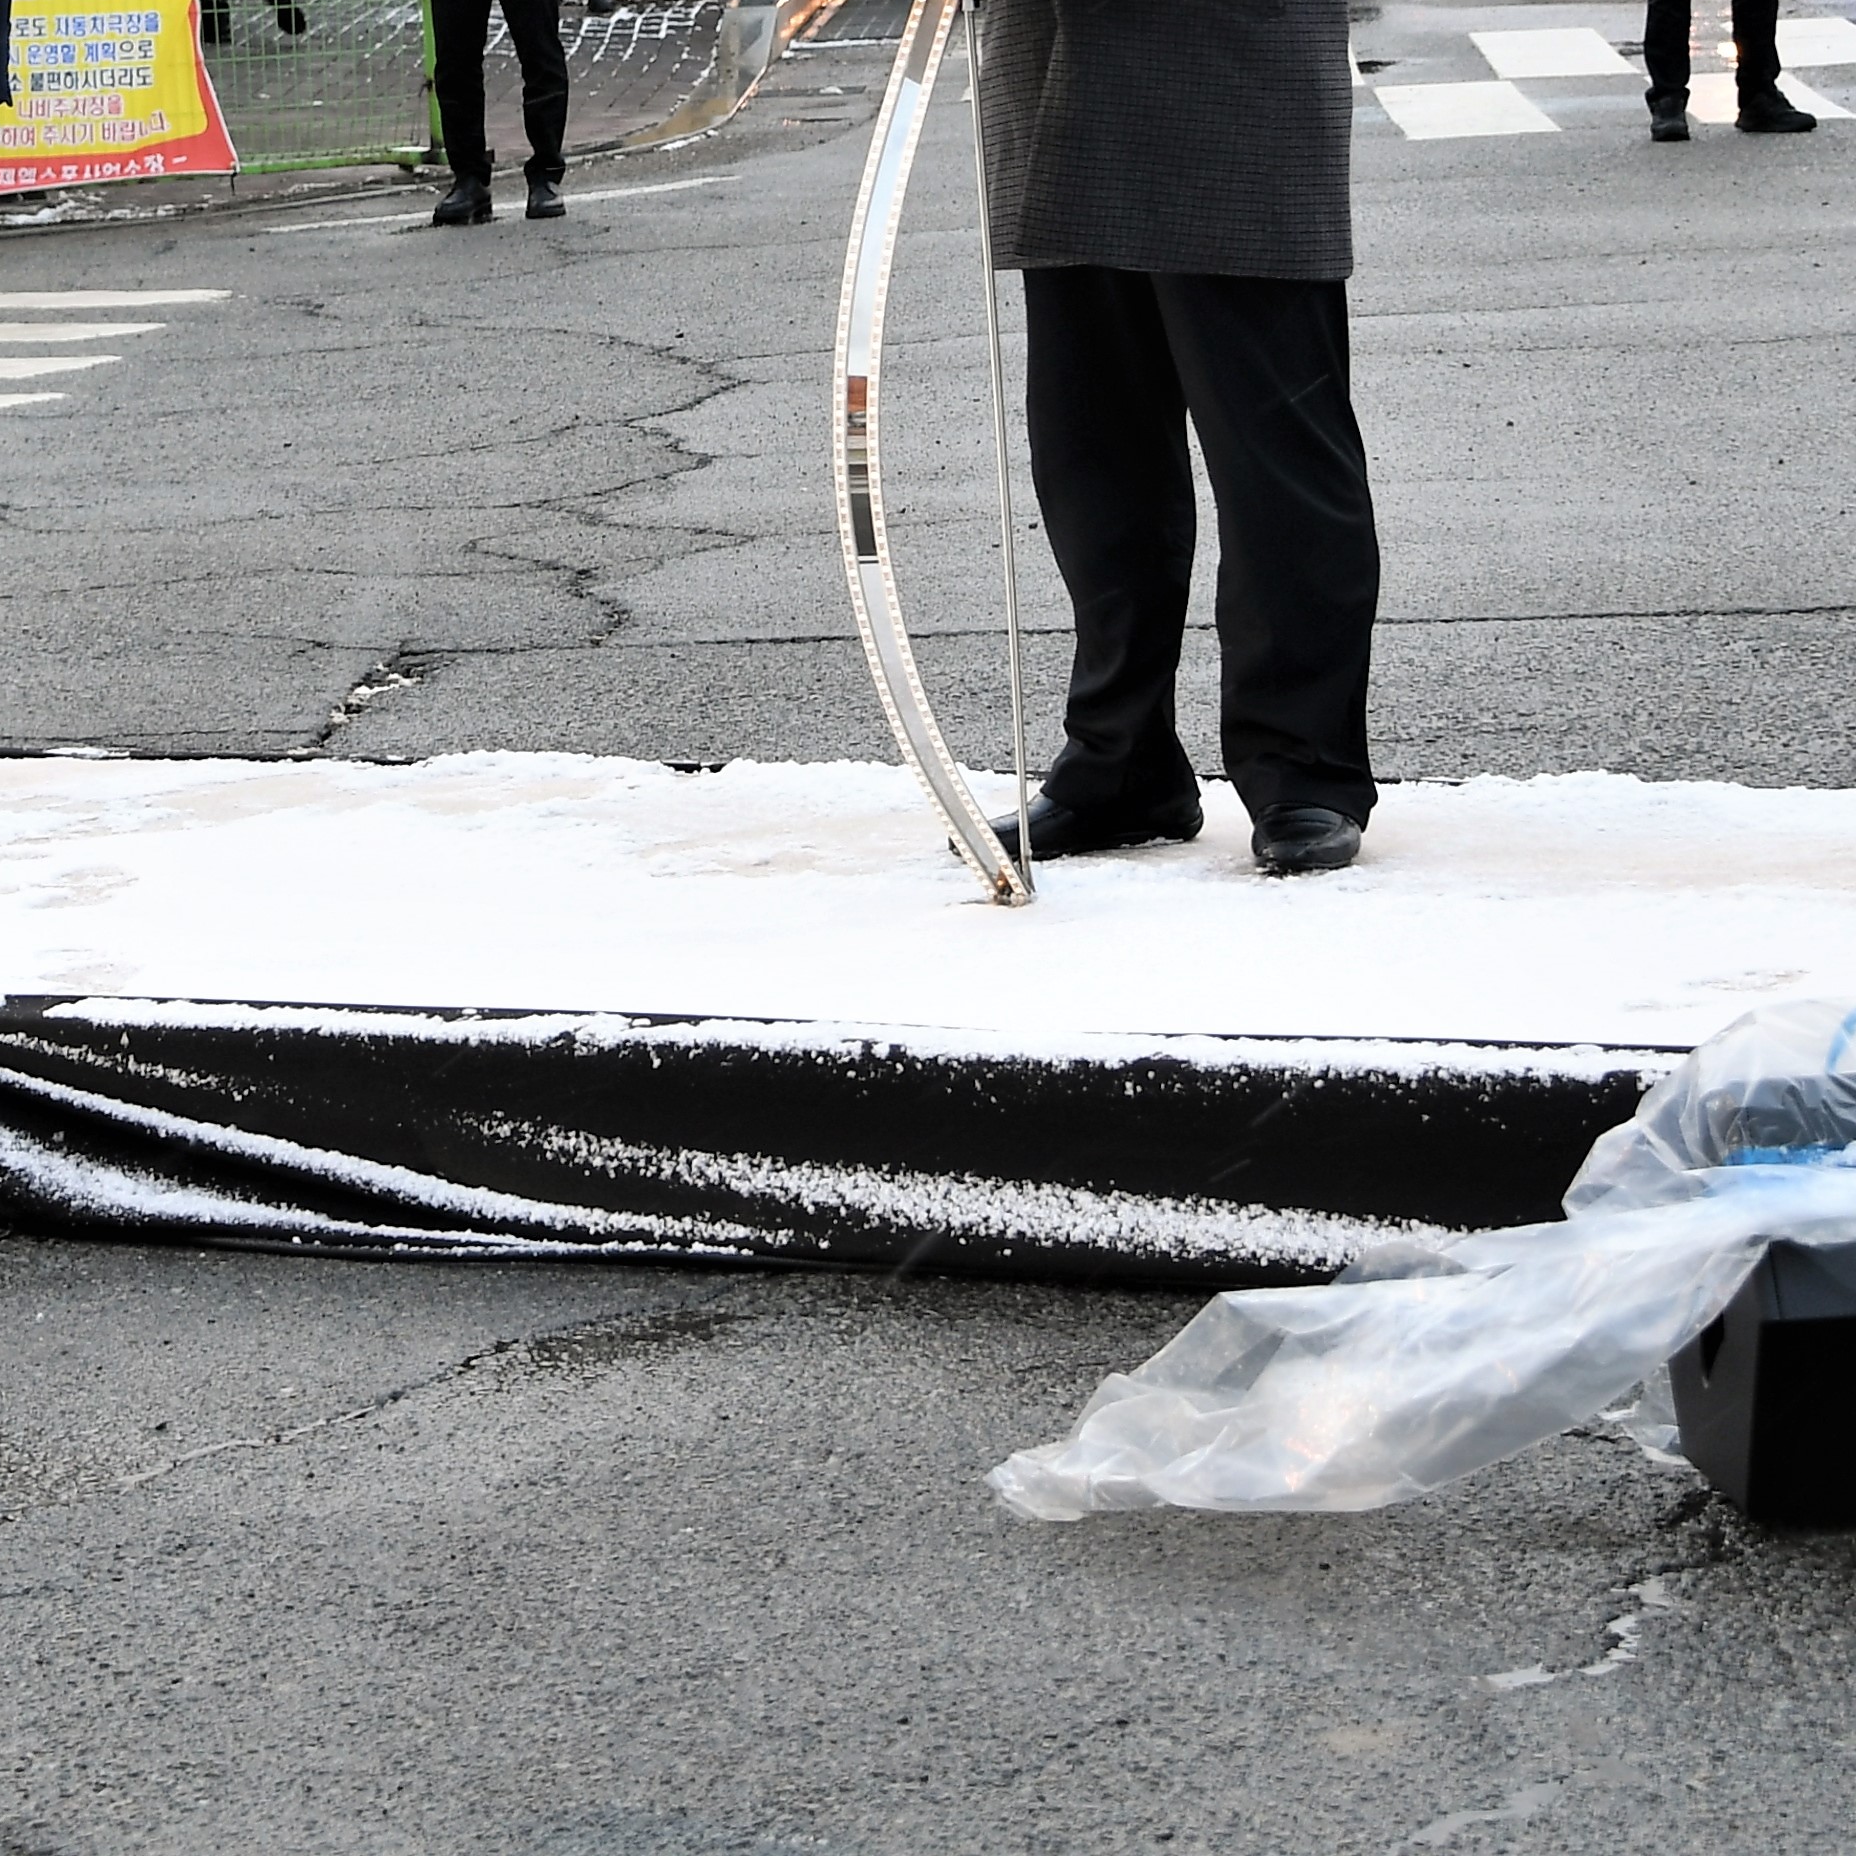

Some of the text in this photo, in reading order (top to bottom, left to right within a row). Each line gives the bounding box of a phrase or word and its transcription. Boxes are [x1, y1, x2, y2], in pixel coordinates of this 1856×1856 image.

[27, 44, 76, 65] 운영할
[84, 40, 154, 61] 계획으로
[43, 124, 94, 145] 주시기
